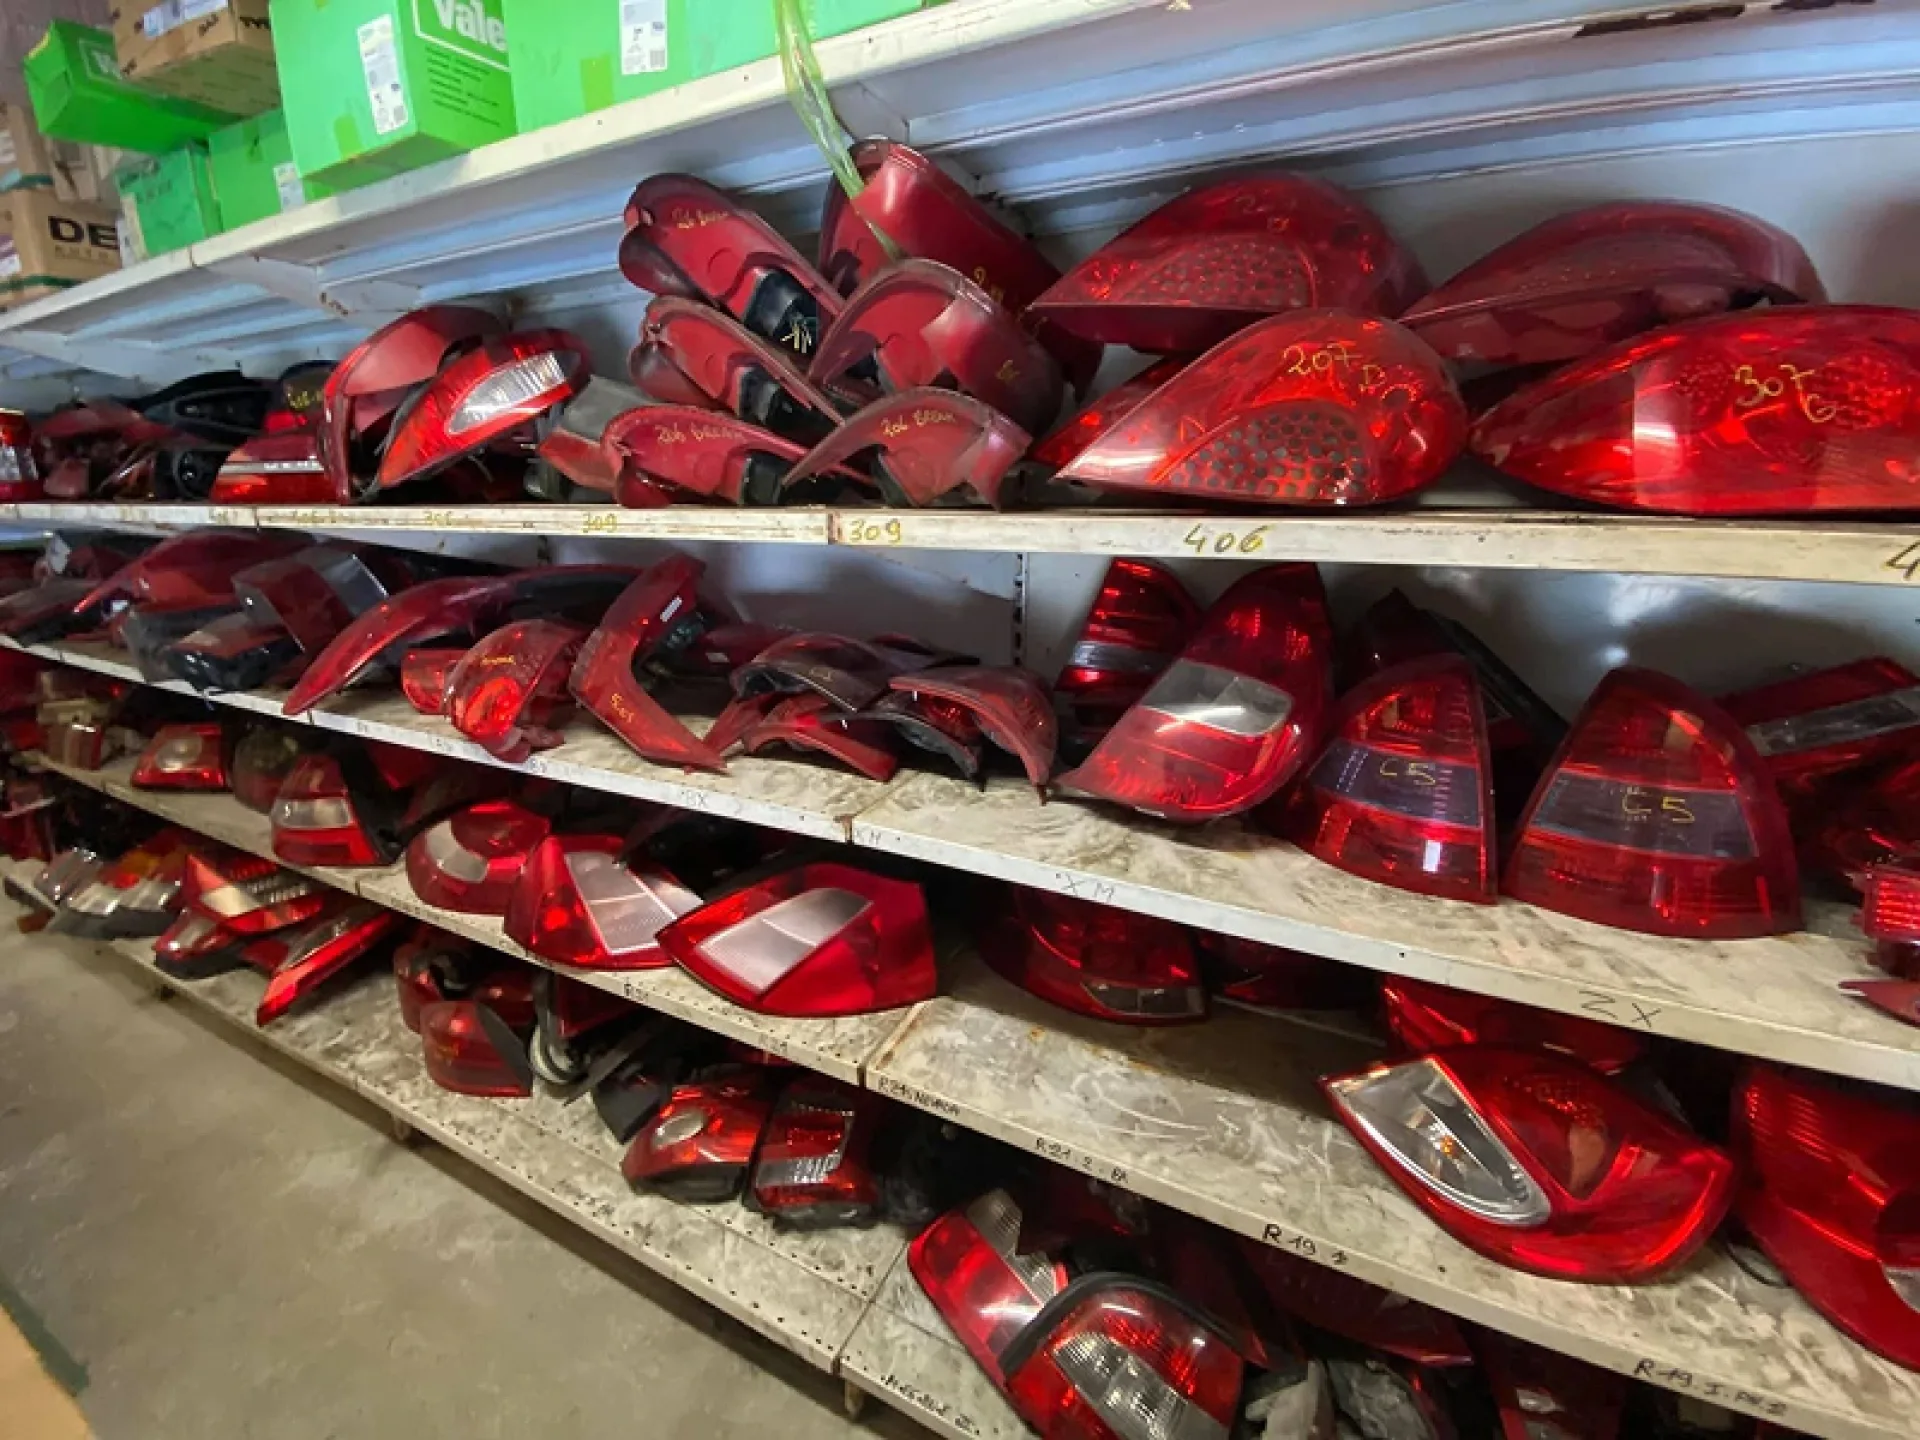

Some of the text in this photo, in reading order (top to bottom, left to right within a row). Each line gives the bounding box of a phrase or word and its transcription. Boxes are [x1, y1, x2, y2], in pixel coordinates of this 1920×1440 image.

[1283, 342, 1362, 375] 207
[1734, 364, 1815, 406] 307
[849, 518, 901, 543] 309
[1183, 522, 1277, 553] 406
